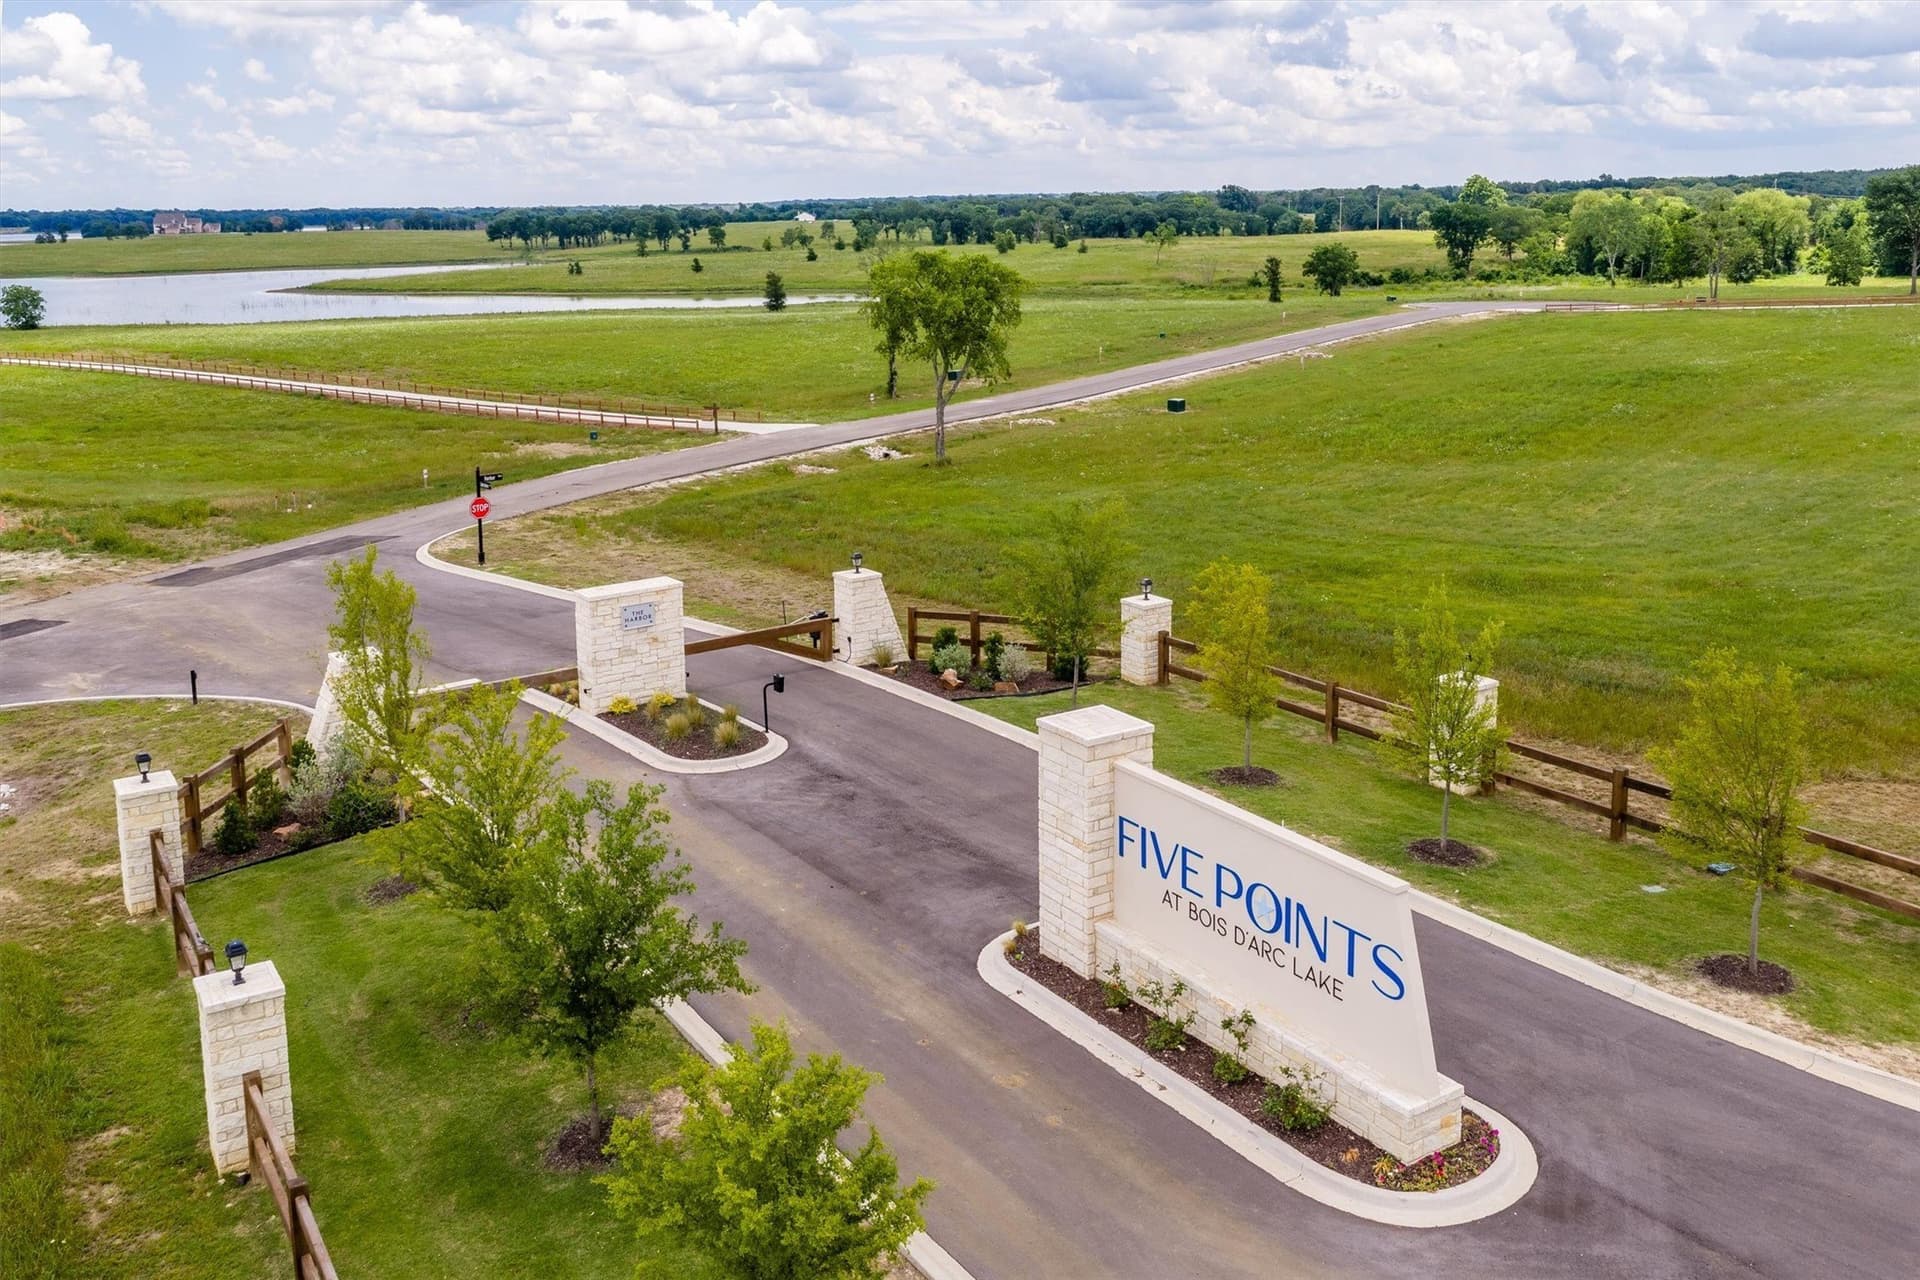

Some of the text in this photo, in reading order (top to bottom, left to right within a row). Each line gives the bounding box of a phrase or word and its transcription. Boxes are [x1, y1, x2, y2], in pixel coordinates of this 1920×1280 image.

[472, 503, 489, 513] STOP
[625, 614, 652, 623] HARBOR
[1118, 815, 1406, 1001] FIVE POINTS
[1161, 889, 1344, 1002] AT BOIS D'ARC LAKE
